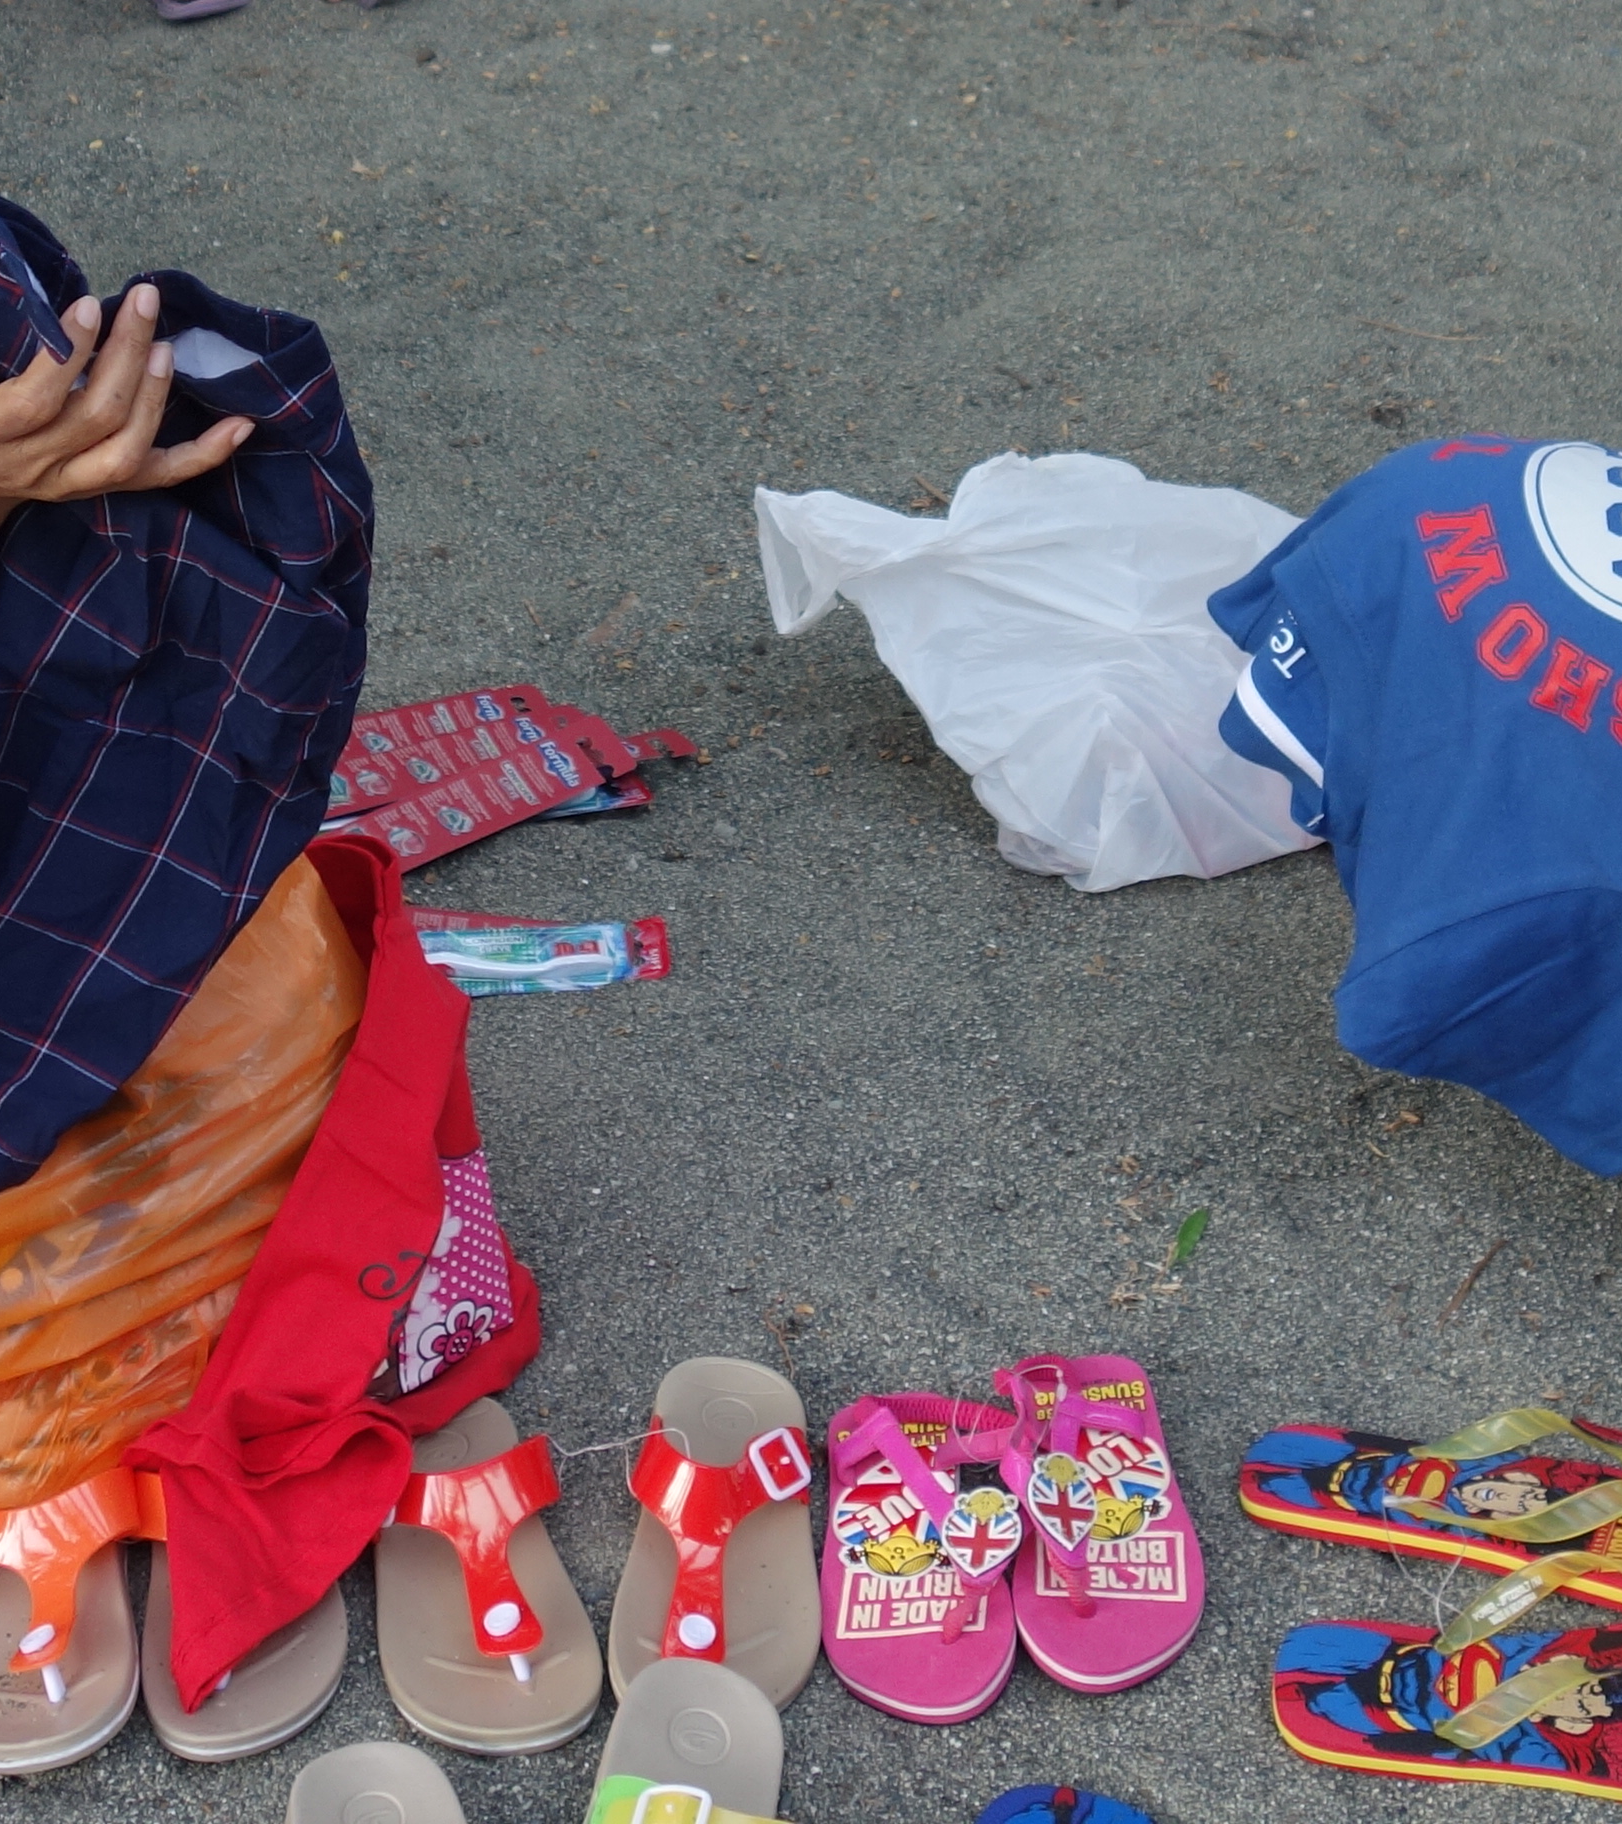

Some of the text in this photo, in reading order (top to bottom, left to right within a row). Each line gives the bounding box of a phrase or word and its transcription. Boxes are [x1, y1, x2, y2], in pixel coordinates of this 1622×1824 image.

[539, 740, 580, 788] Formula
[851, 1599, 974, 1630] ADE IN
